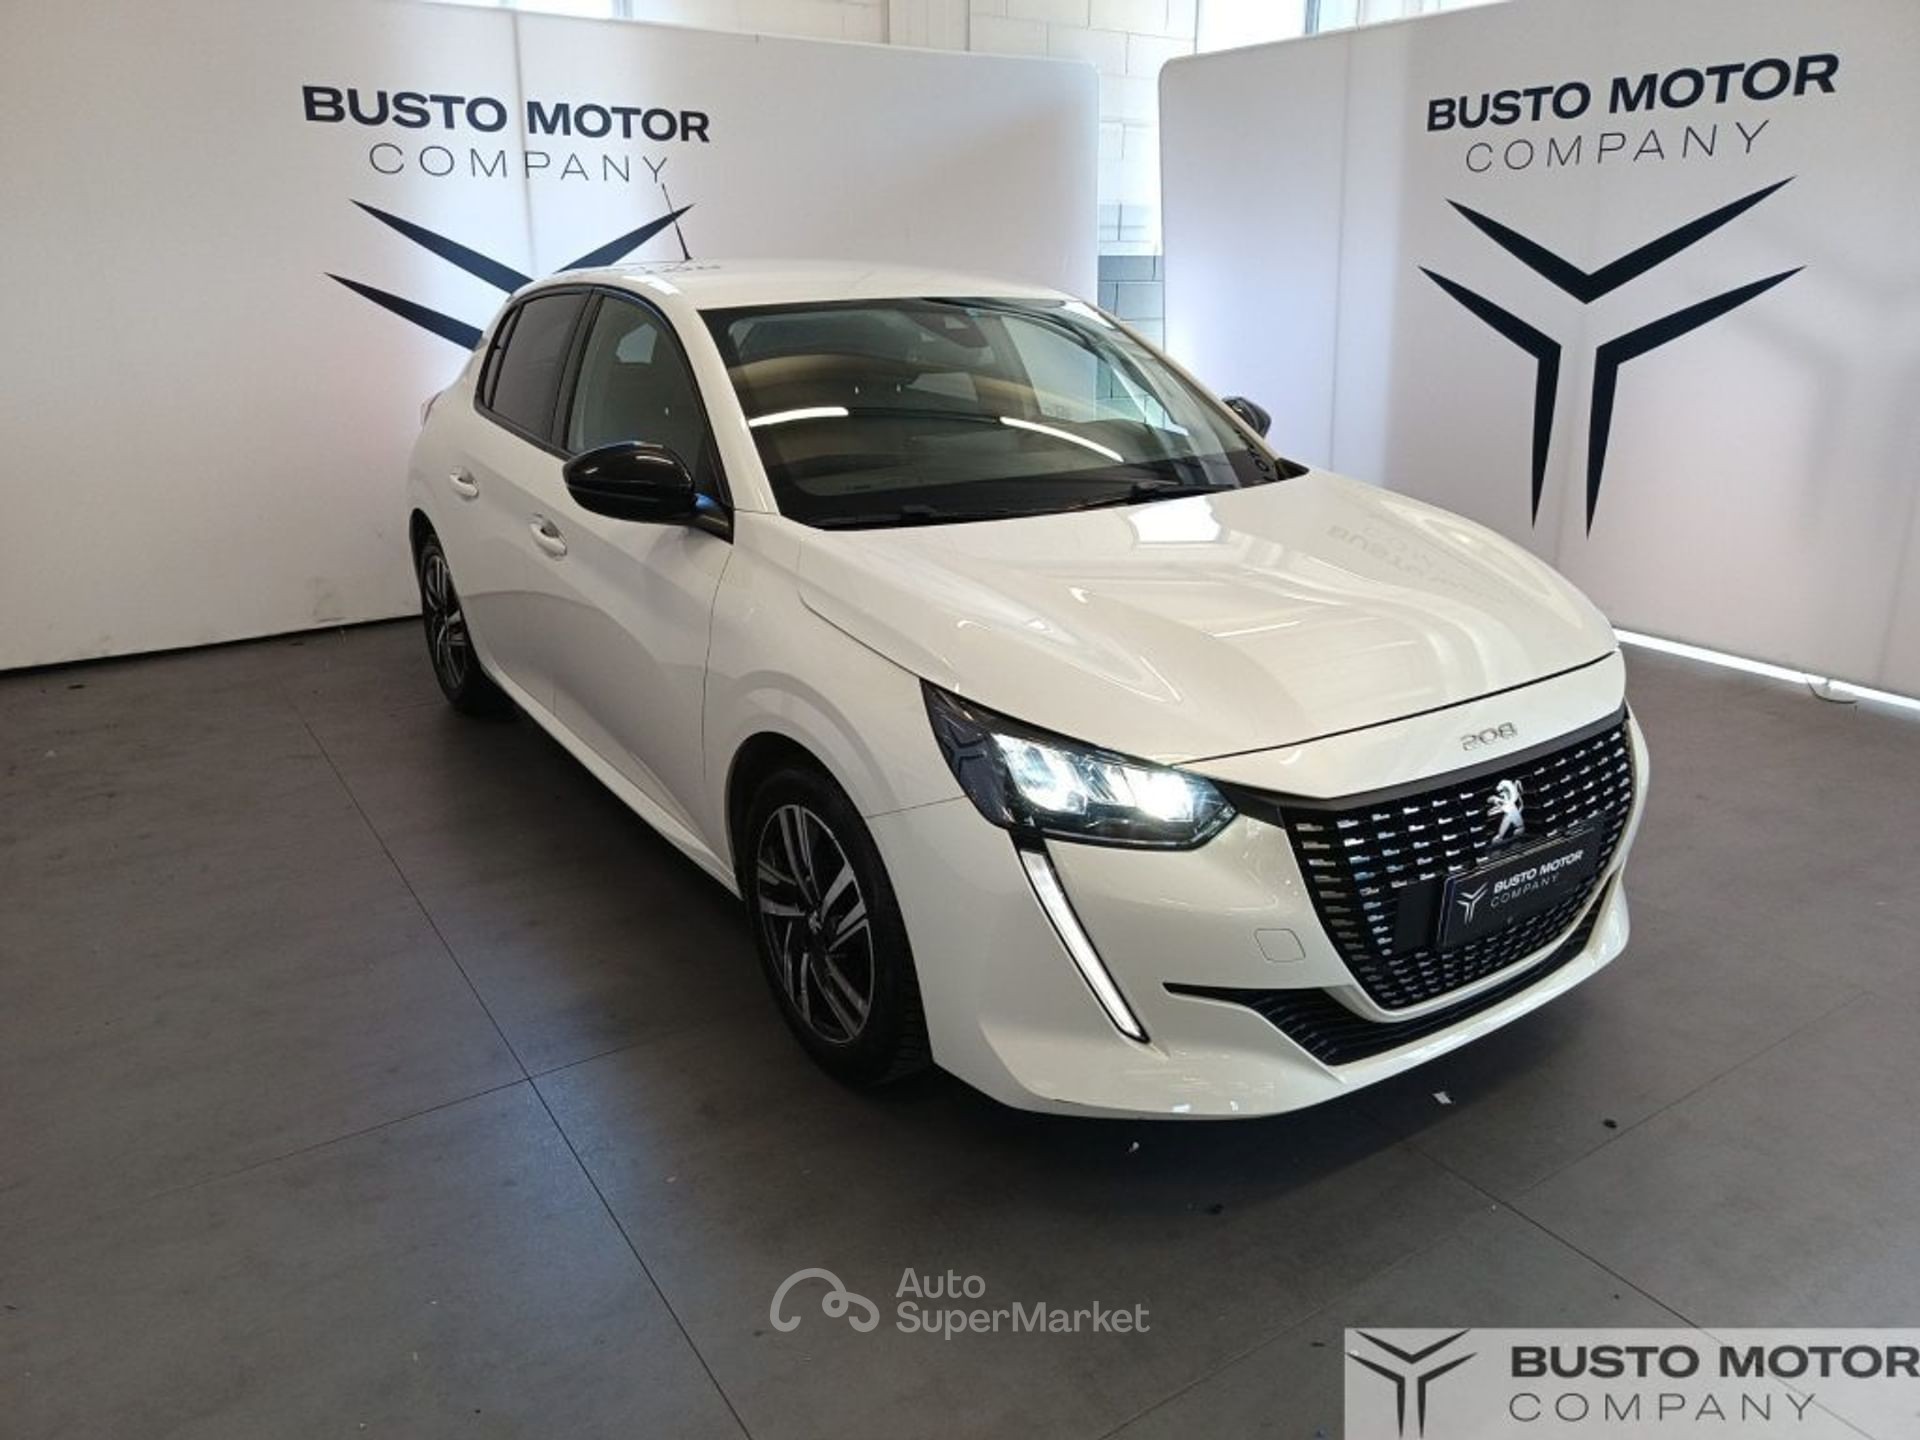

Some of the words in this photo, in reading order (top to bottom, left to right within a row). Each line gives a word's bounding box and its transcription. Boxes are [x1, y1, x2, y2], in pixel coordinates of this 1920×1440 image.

[302, 85, 508, 132] BUSTO
[526, 100, 710, 143] MOTOR
[1427, 82, 1591, 132] BUSTO
[1609, 53, 1839, 114] MOTOR
[369, 142, 668, 184] COMPANY
[1465, 119, 1770, 173] COMPANY
[1460, 722, 1518, 751] 208
[1490, 874, 1560, 908] COMPANY
[1493, 867, 1537, 893] BUSTO
[1539, 849, 1584, 877] MOTOR
